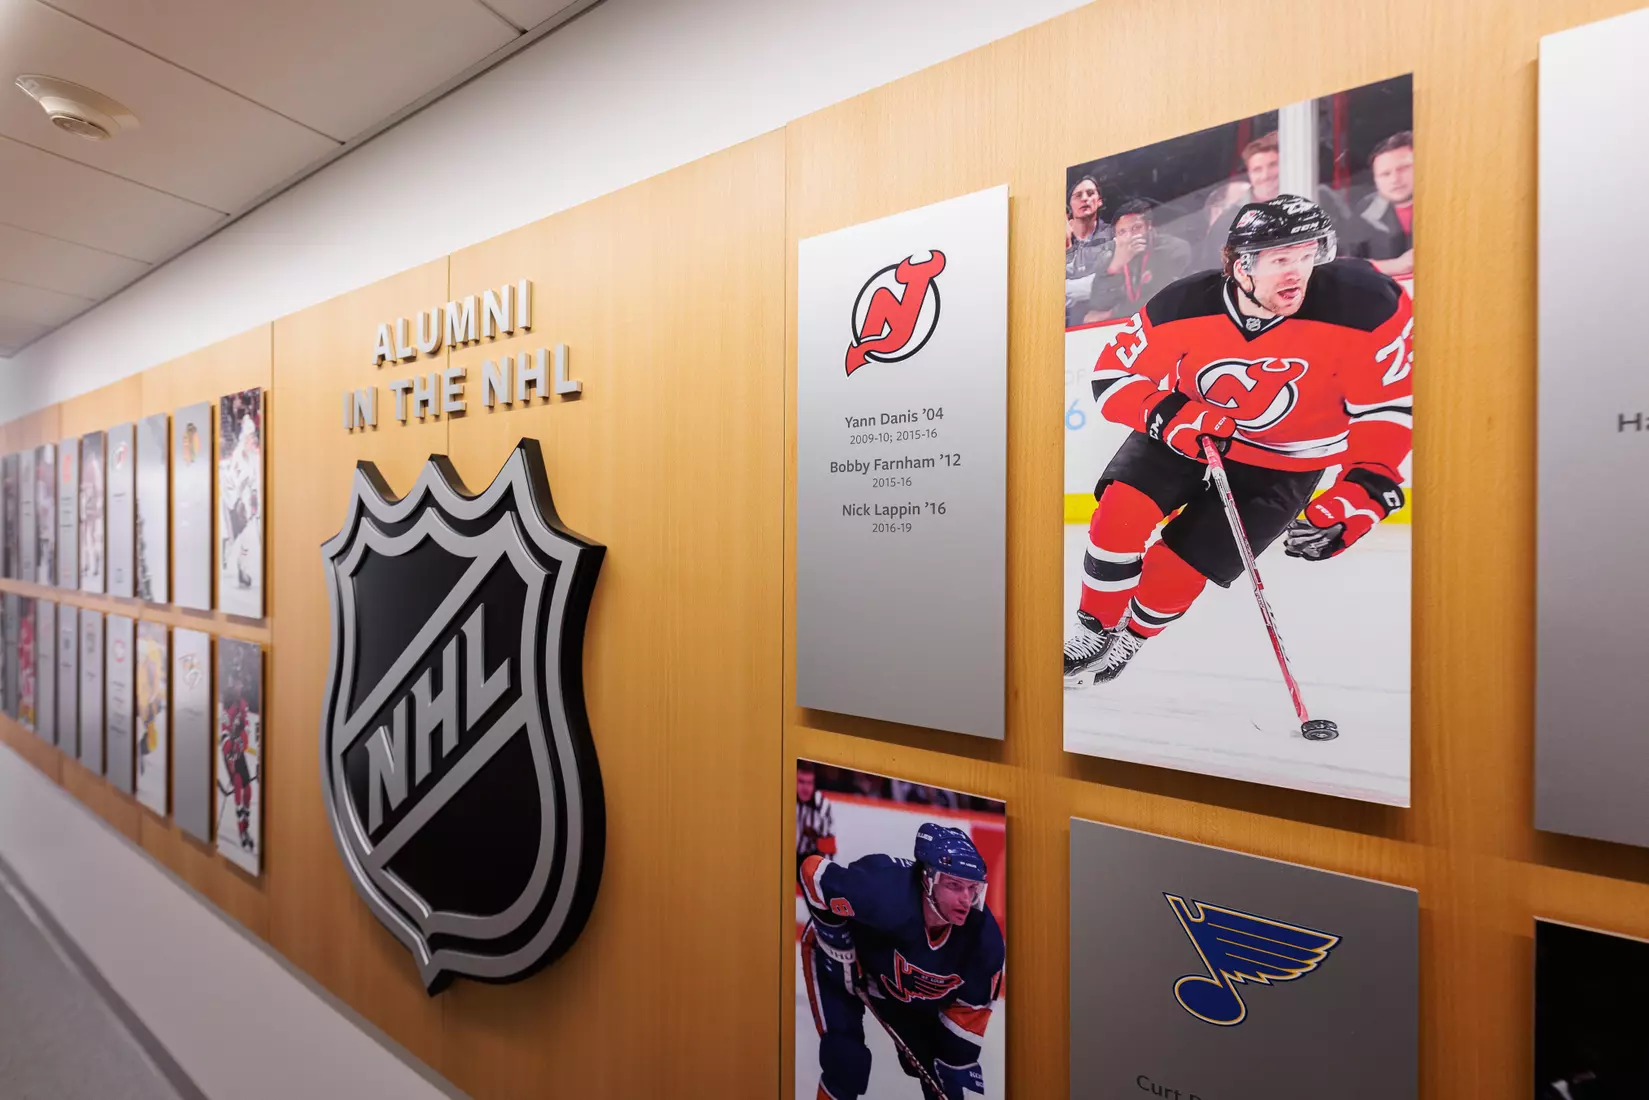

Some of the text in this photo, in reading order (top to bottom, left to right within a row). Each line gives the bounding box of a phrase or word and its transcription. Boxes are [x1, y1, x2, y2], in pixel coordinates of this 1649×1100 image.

[372, 278, 532, 366] ALUMNI
[343, 343, 583, 430] IN THE NHL
[845, 407, 944, 428] Yann Danis ’04
[849, 428, 938, 445] 2009-10; 2015-16
[830, 453, 961, 475] Bobby Farnham ’12
[872, 476, 912, 488] 2015-16
[842, 502, 947, 519] Nick Lappin ’16
[872, 522, 912, 533] 2016-19
[364, 602, 512, 836] NHL
[1136, 1075, 1182, 1100] Curt
